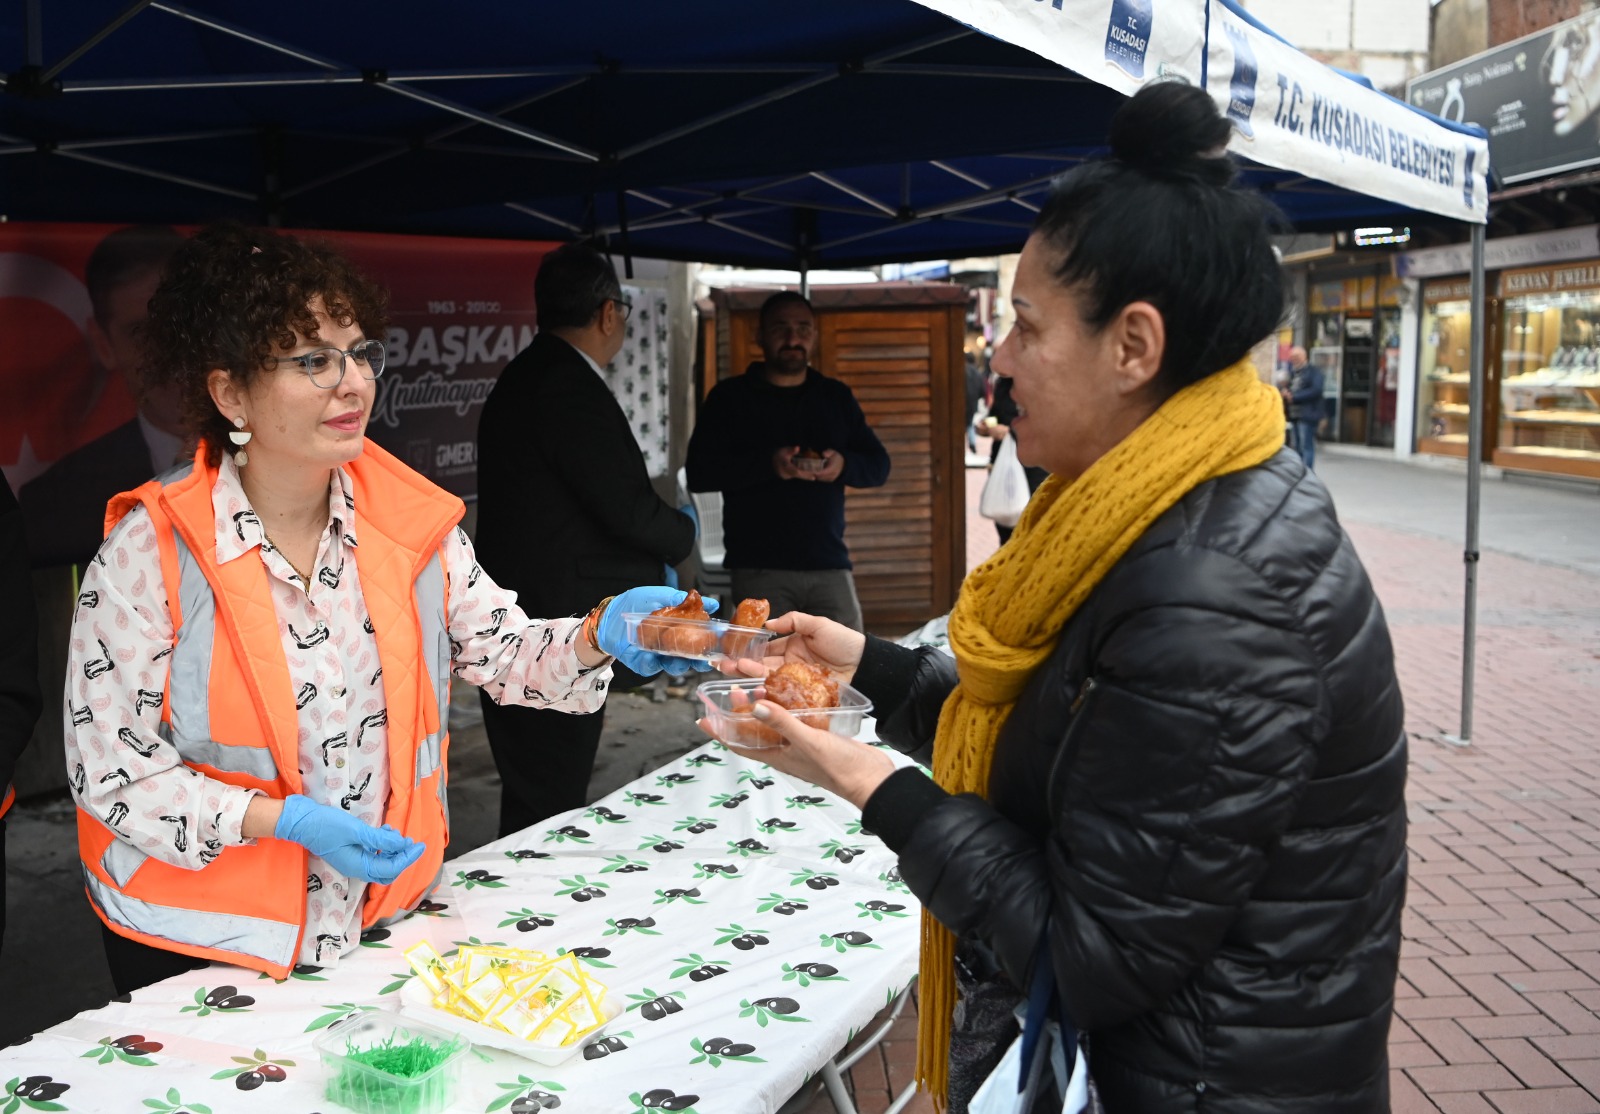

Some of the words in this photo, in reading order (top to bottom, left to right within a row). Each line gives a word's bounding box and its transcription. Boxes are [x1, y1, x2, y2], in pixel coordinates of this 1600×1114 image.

[1127, 16, 1138, 31] T.C.
[1110, 24, 1147, 52] KUŞADASI
[1274, 72, 1304, 136] T.C.
[1310, 92, 1387, 165] KUŞADASI
[1388, 127, 1456, 187] BELEDİYESİ
[1507, 271, 1549, 292] KERVAN
[428, 301, 456, 315] 1963
